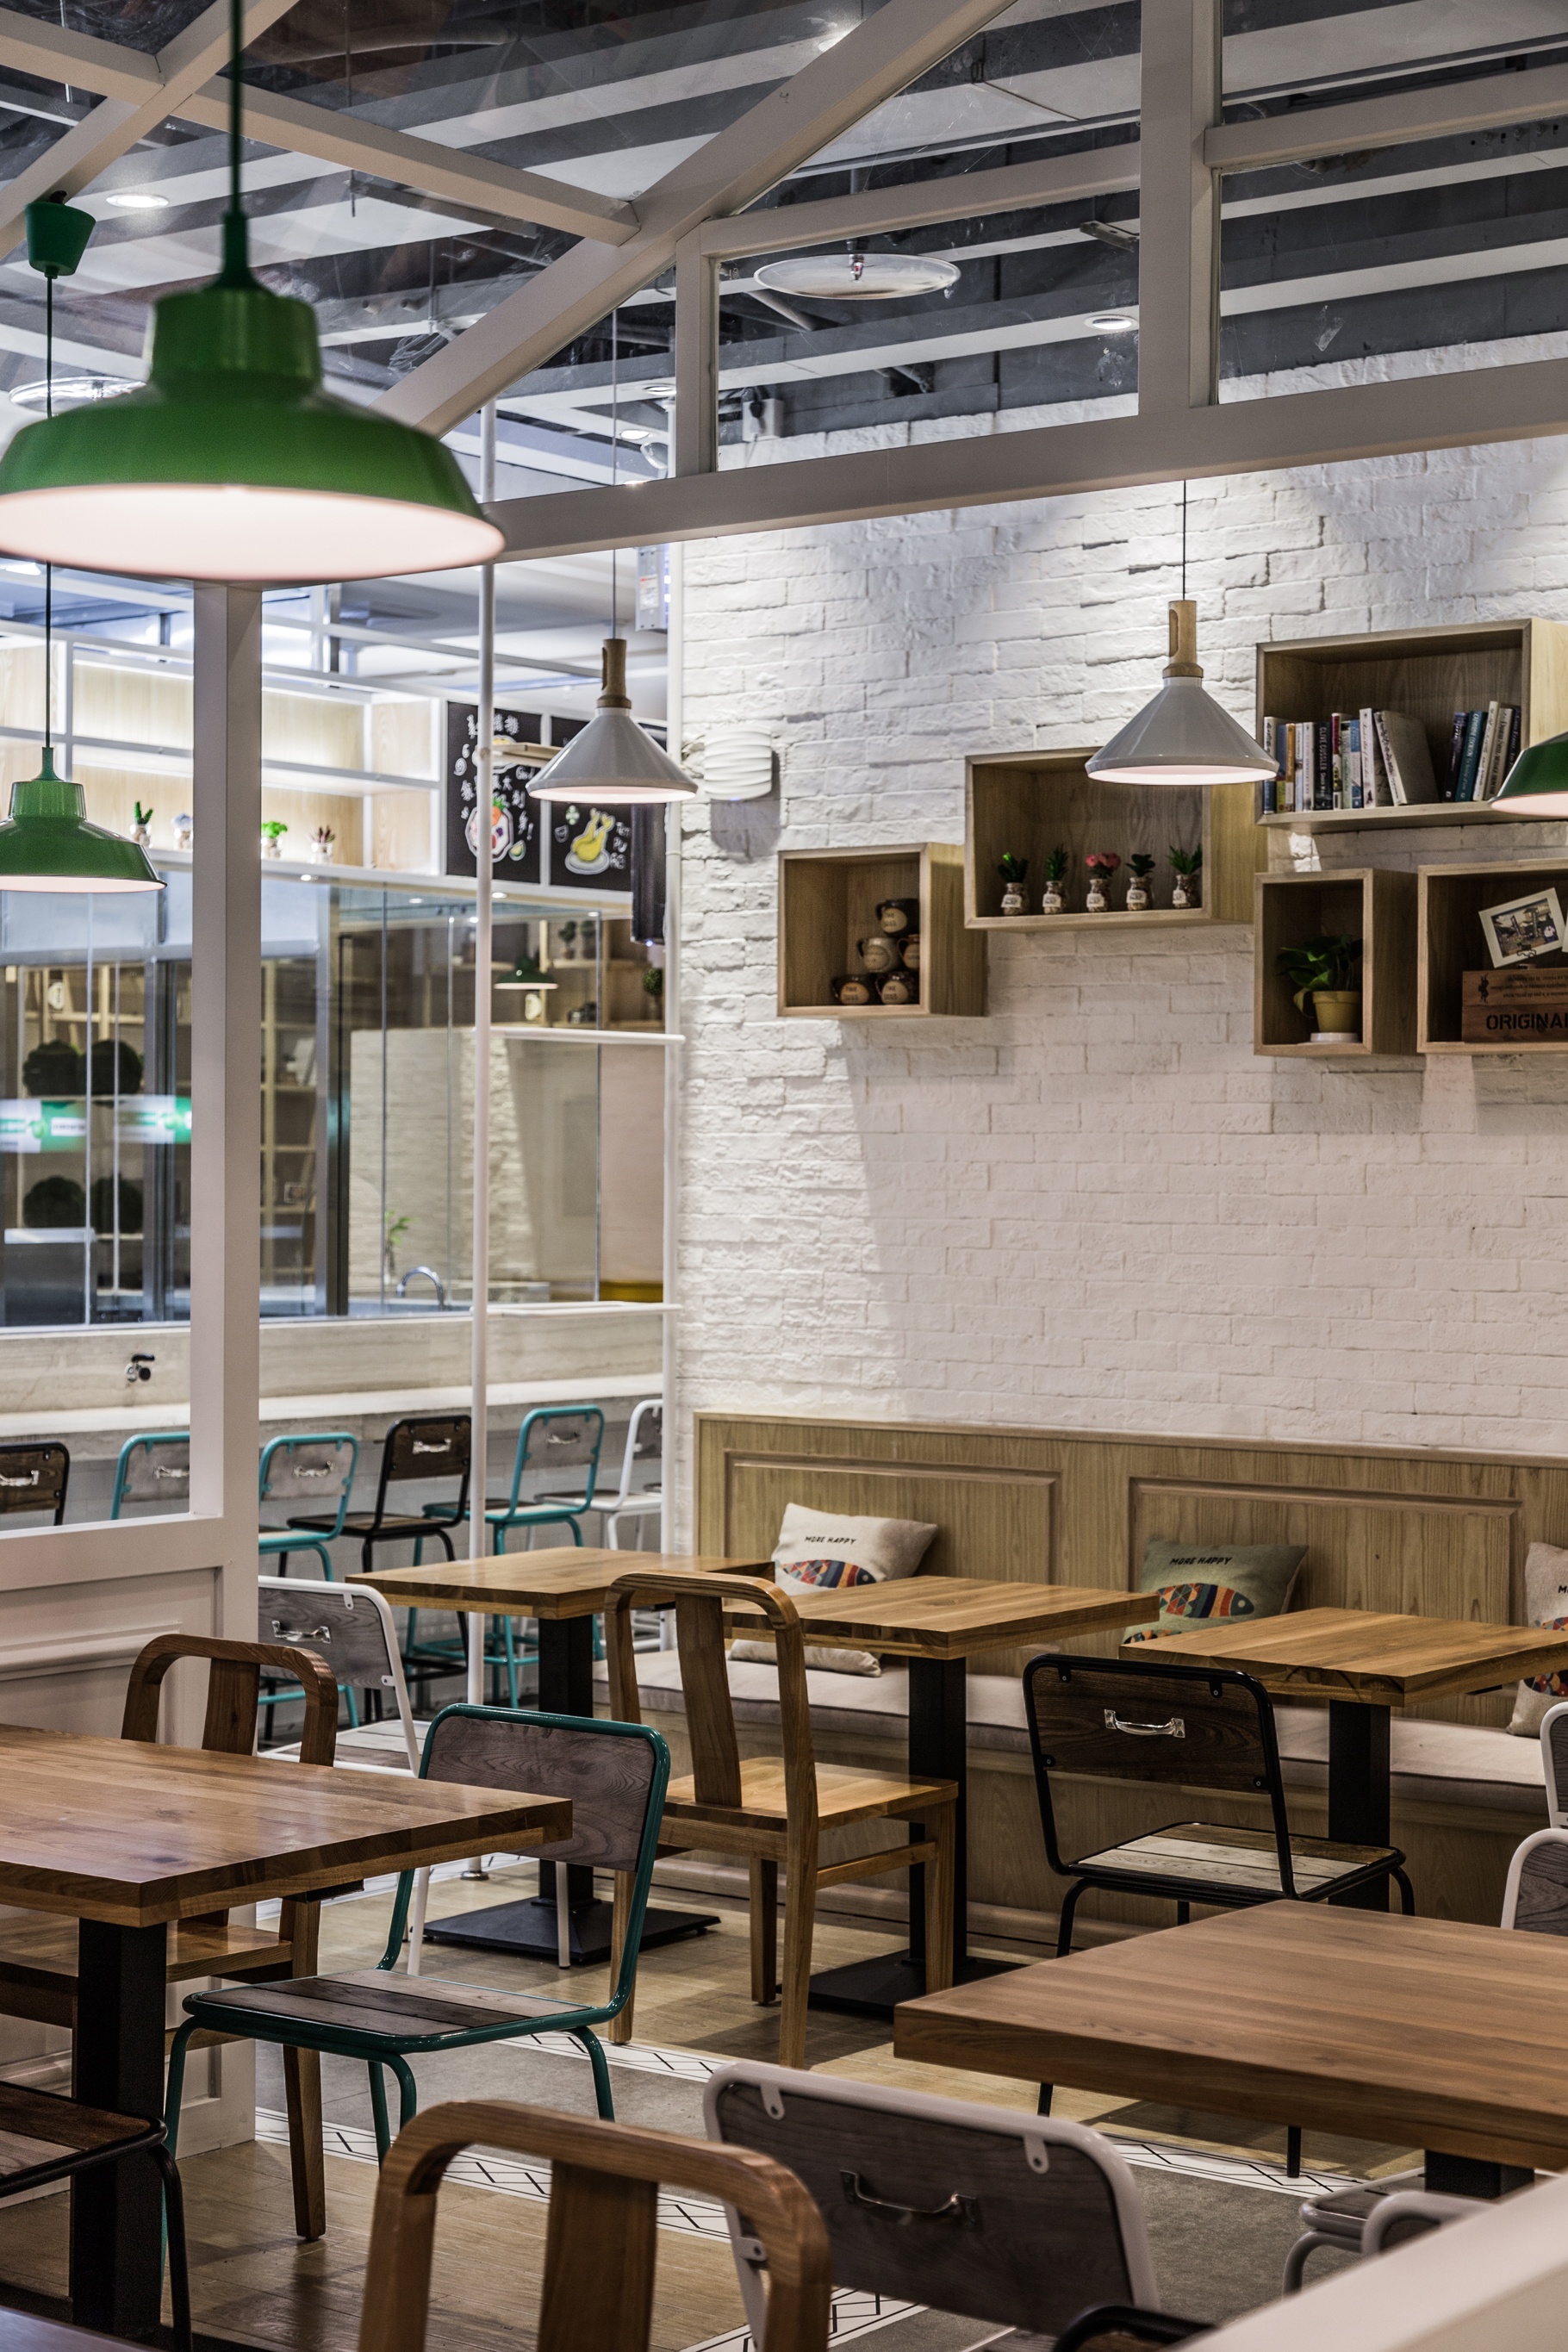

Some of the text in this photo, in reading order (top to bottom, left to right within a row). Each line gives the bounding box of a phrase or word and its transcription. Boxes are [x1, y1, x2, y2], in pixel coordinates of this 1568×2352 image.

[1319, 726, 1328, 743] CLIVE
[1466, 737, 1477, 757] COOKSON
[1319, 744, 1328, 770] CUSSLER
[1559, 1585, 1568, 1594] M
